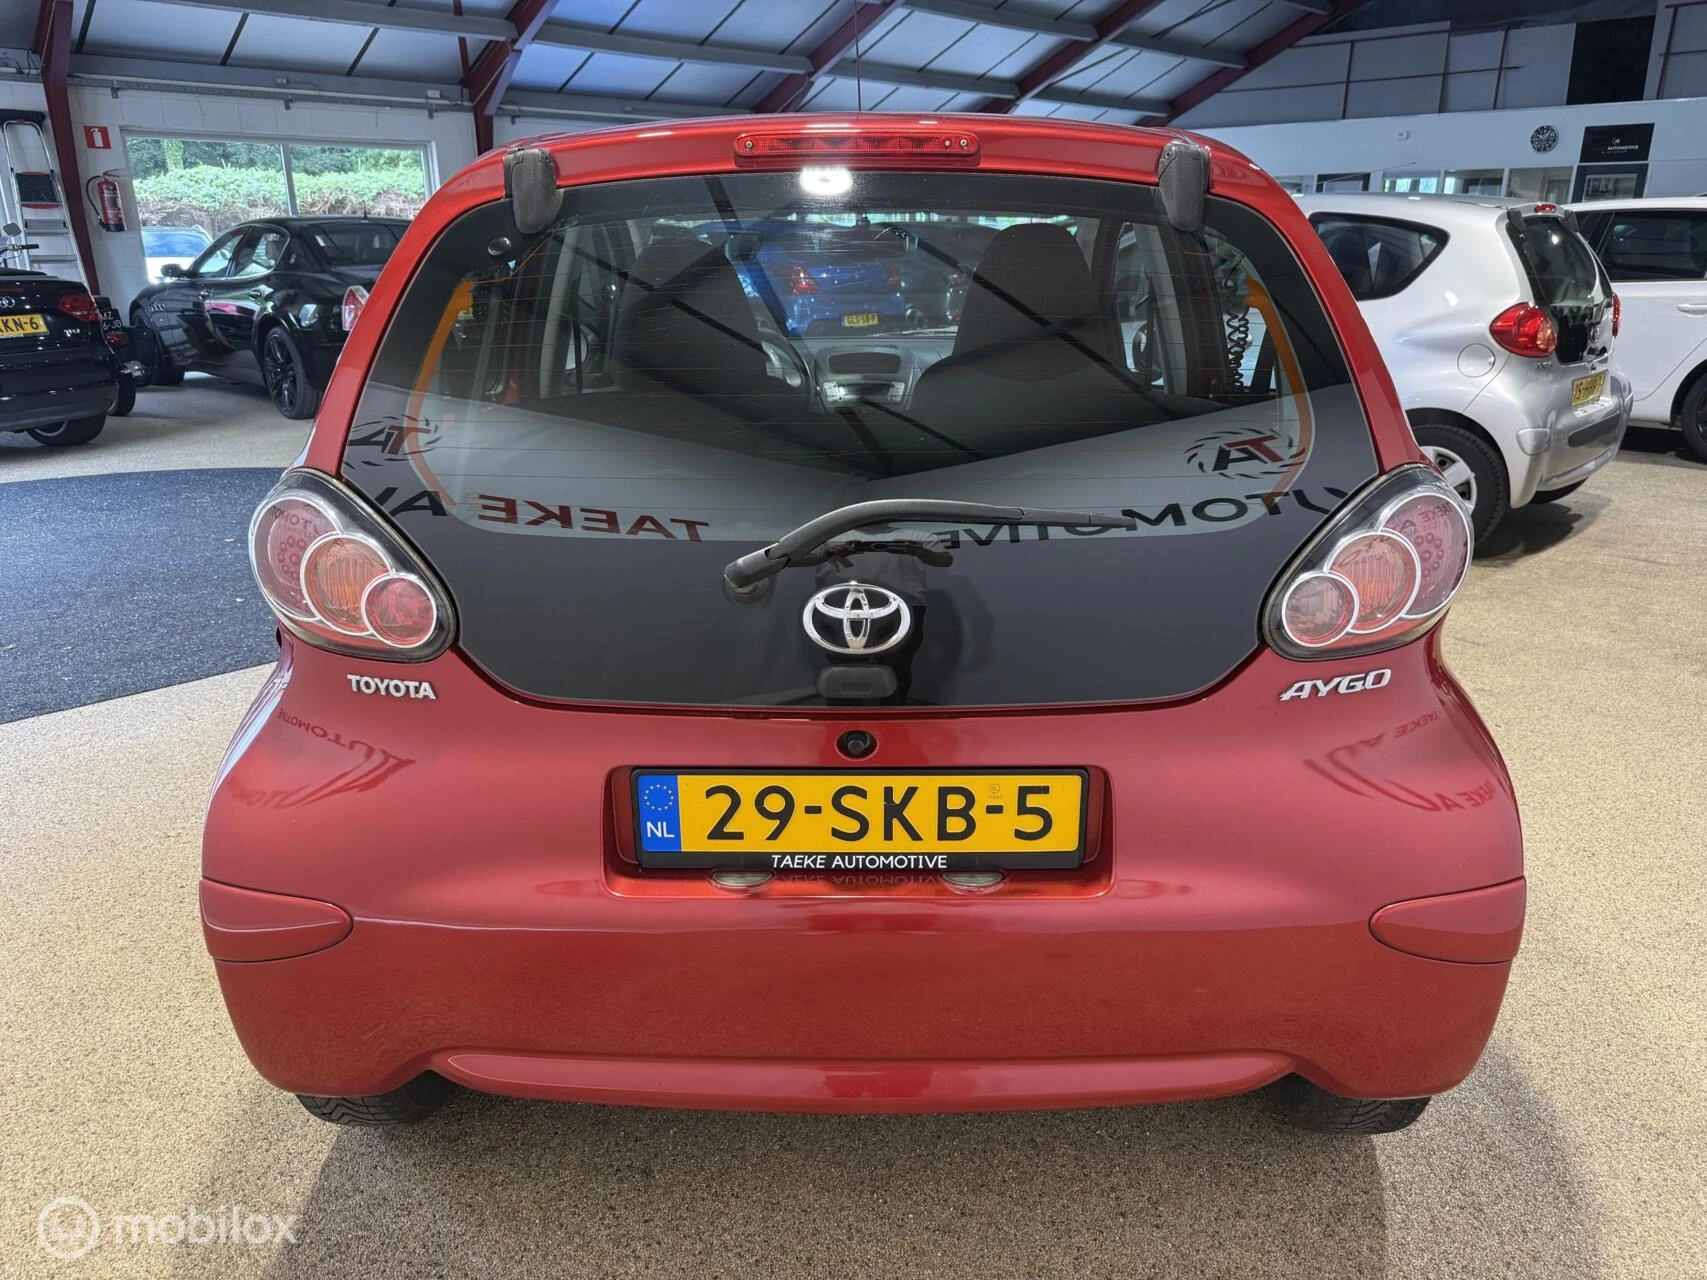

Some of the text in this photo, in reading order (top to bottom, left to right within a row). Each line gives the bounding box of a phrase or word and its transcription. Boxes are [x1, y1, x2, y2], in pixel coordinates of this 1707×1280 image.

[0, 317, 39, 333] KN-6
[347, 674, 436, 700] TOYOTA
[1279, 668, 1392, 701] AYGO
[705, 784, 1053, 841] 29-SKB-5
[646, 821, 675, 838] NL
[771, 855, 948, 869] TAEKE AUTOMOTIVE
